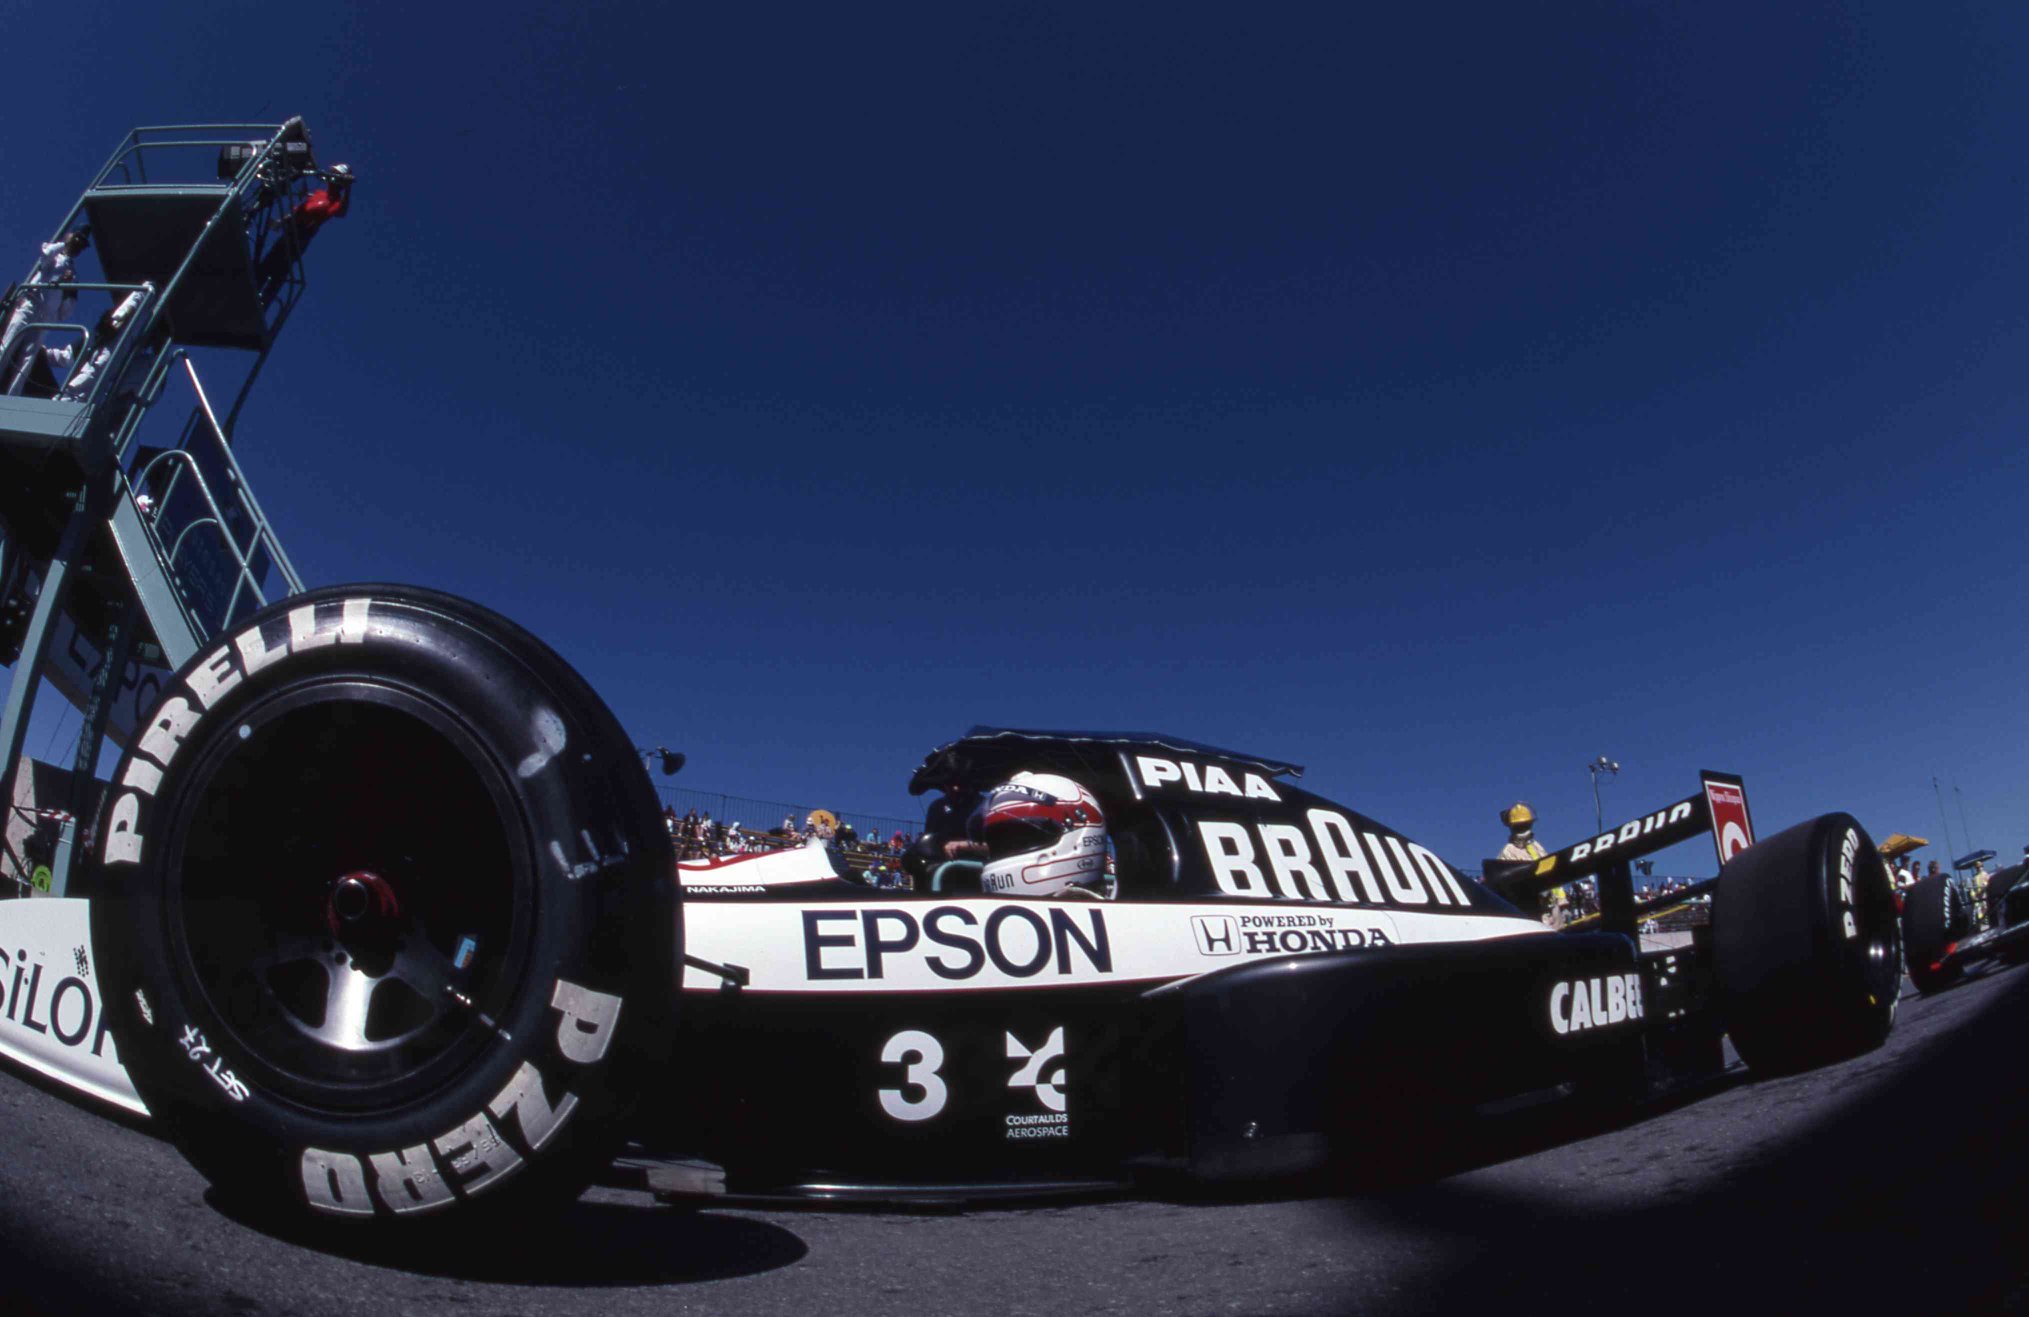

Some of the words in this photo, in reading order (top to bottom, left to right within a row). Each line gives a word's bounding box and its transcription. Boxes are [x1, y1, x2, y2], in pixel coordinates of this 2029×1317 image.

[104, 598, 371, 864] PIRELLI
[1136, 755, 1281, 801] PIAA
[1197, 808, 1471, 906] BRAUN
[1840, 828, 1860, 906] ZERO
[686, 886, 766, 894] NAKAJIMA
[801, 906, 1113, 981] EPSON
[1241, 915, 1316, 930] POWERED
[1318, 914, 1334, 930] by
[1244, 926, 1394, 954] HONDA
[550, 979, 622, 1063] P
[202, 1056, 250, 1102] SET
[879, 1029, 947, 1122] 3
[300, 1060, 579, 1215] ZERO
[1006, 1113, 1068, 1125] COURTAULDS
[1006, 1125, 1069, 1138] AEROSPACE
